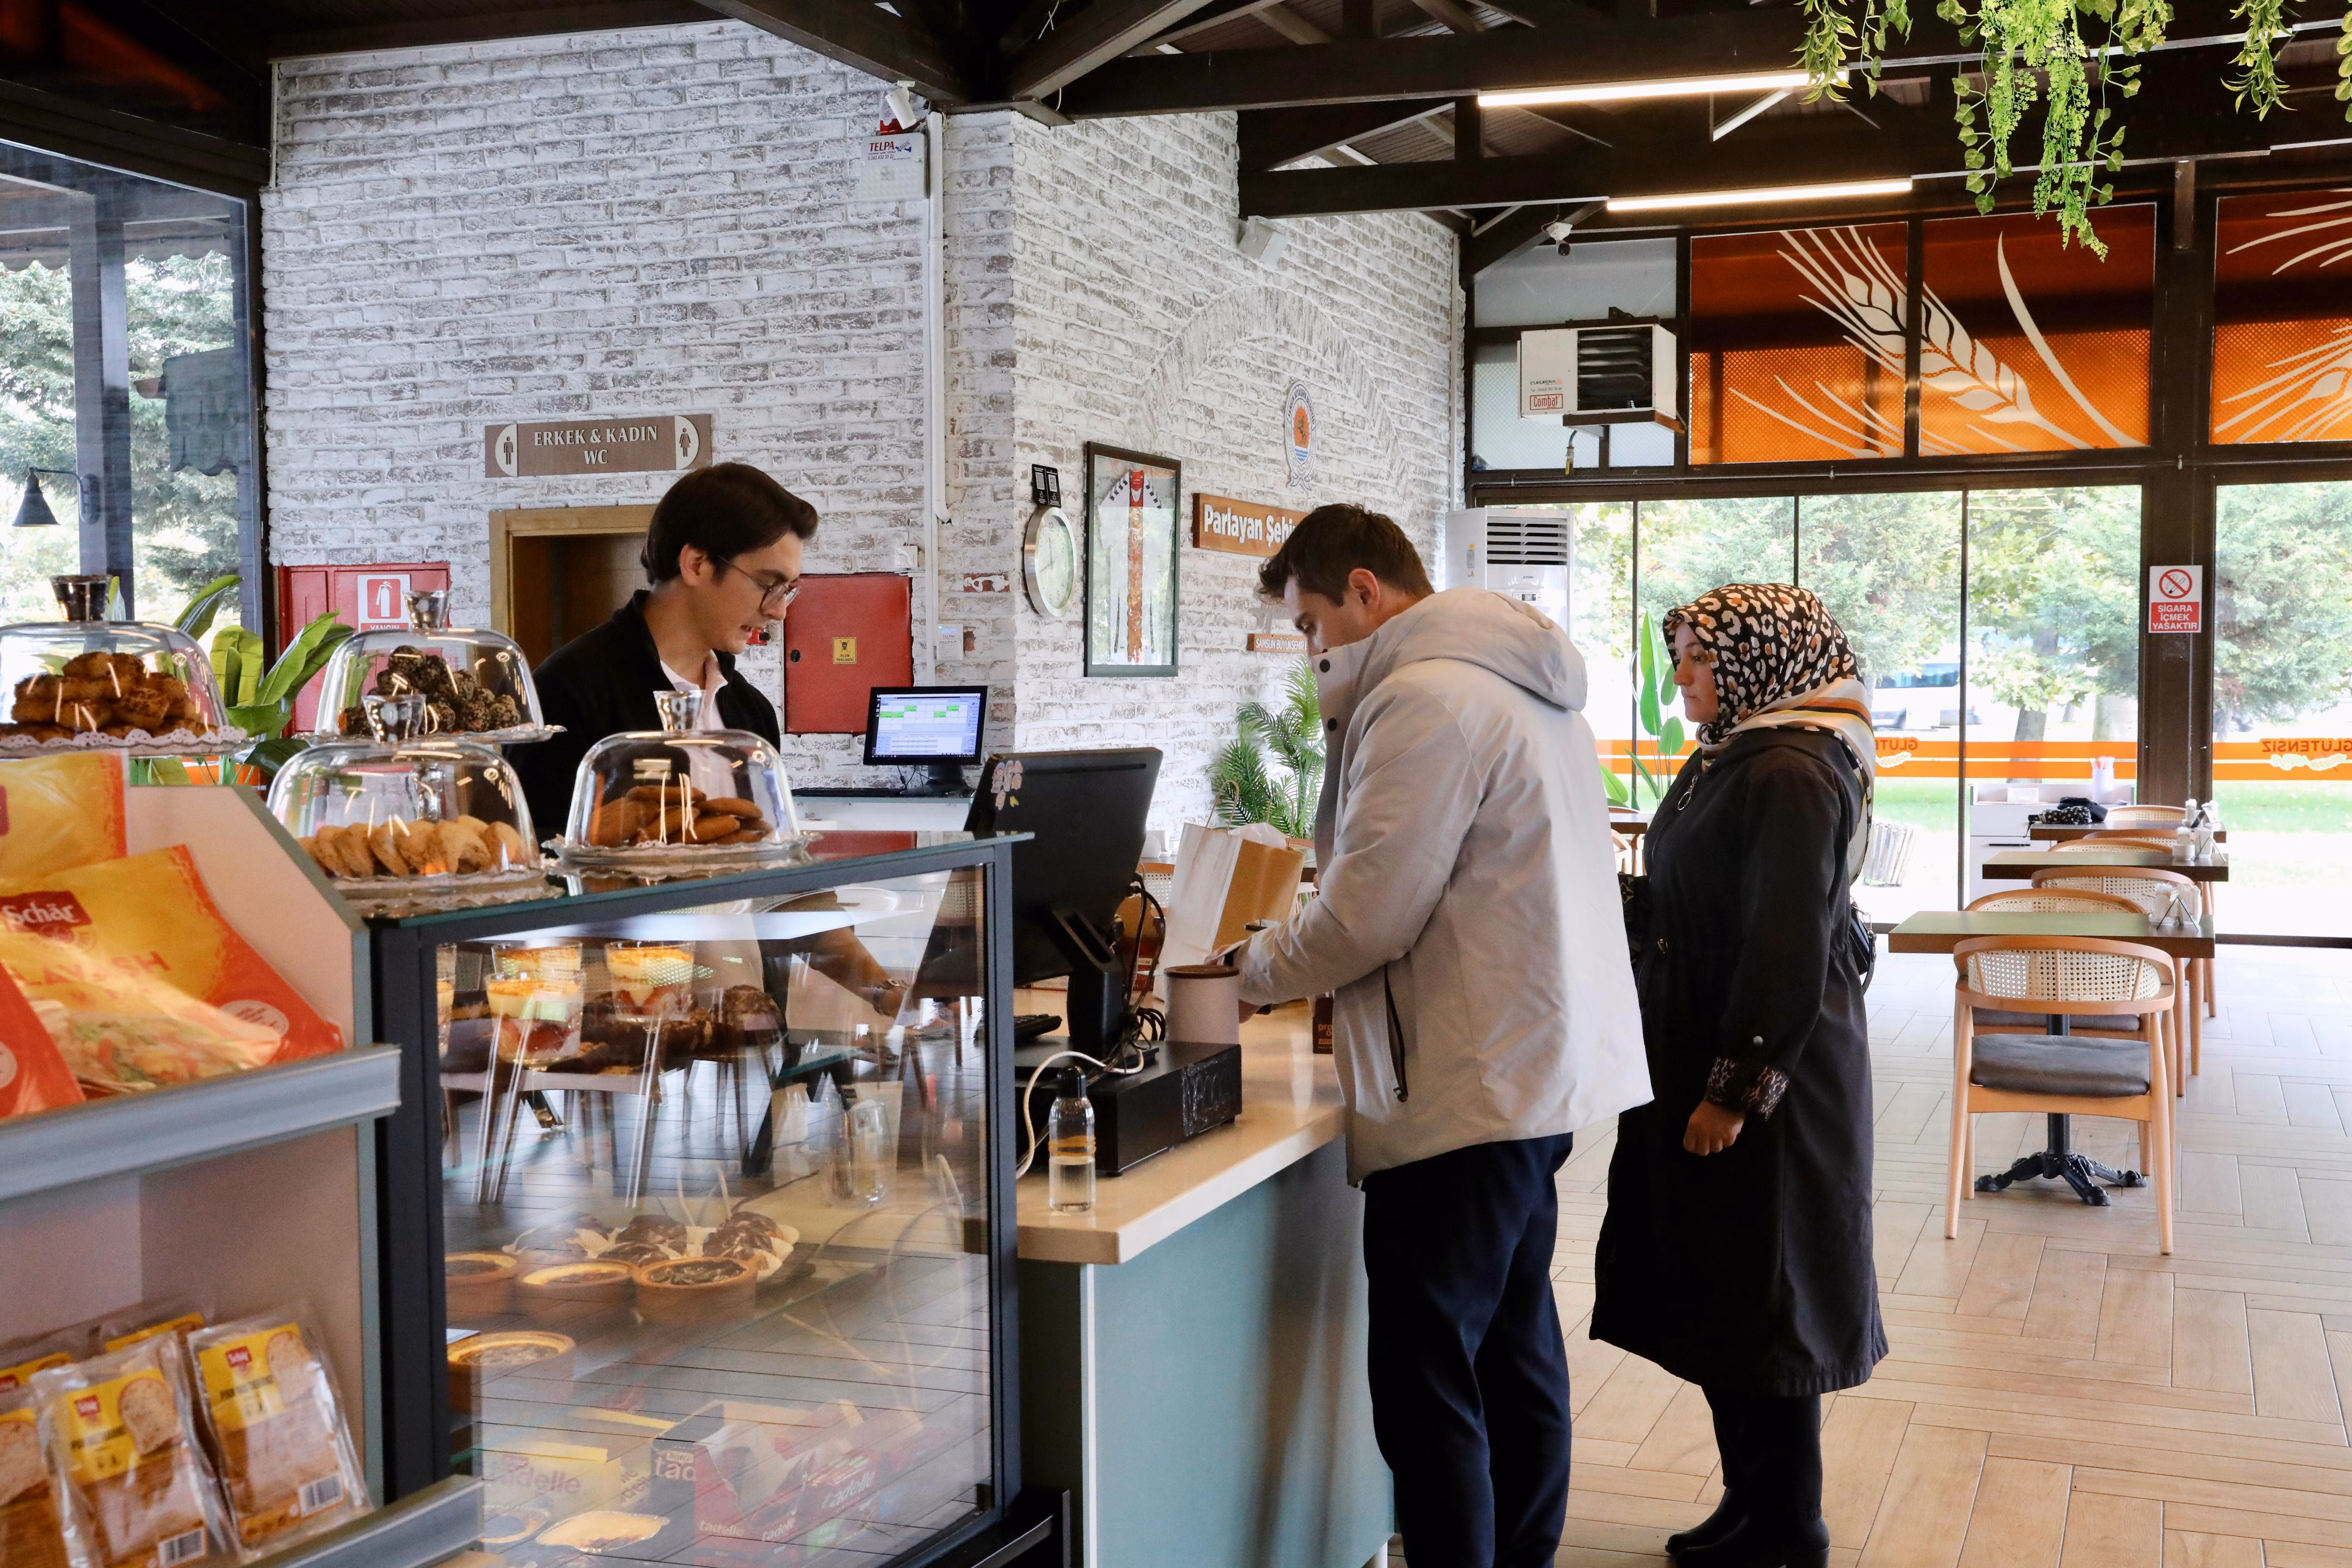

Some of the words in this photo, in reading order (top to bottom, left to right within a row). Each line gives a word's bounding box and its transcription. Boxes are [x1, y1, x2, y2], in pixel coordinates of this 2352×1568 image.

[870, 141, 894, 152] TELPA
[1534, 396, 1558, 407] Combat
[534, 430, 586, 446] ERKEK
[590, 429, 601, 443] &
[606, 425, 658, 443] KADIN
[584, 449, 608, 464] WC
[1048, 521, 1053, 532] 12
[1204, 504, 1263, 543] Parlayan
[1062, 543, 1064, 553] 2
[1063, 561, 1066, 571] 3
[1061, 579, 1065, 588] 4
[1050, 594, 1052, 604] 6
[1057, 590, 1059, 600] 5
[2158, 603, 2193, 612] SİGARA
[2160, 612, 2189, 622] İÇMEK
[1256, 639, 1275, 649] SAMSUN
[1277, 638, 1304, 651] BÜYÜKŞEHİR
[2, 901, 79, 925] Schär
[700, 1520, 744, 1537] tadelle
